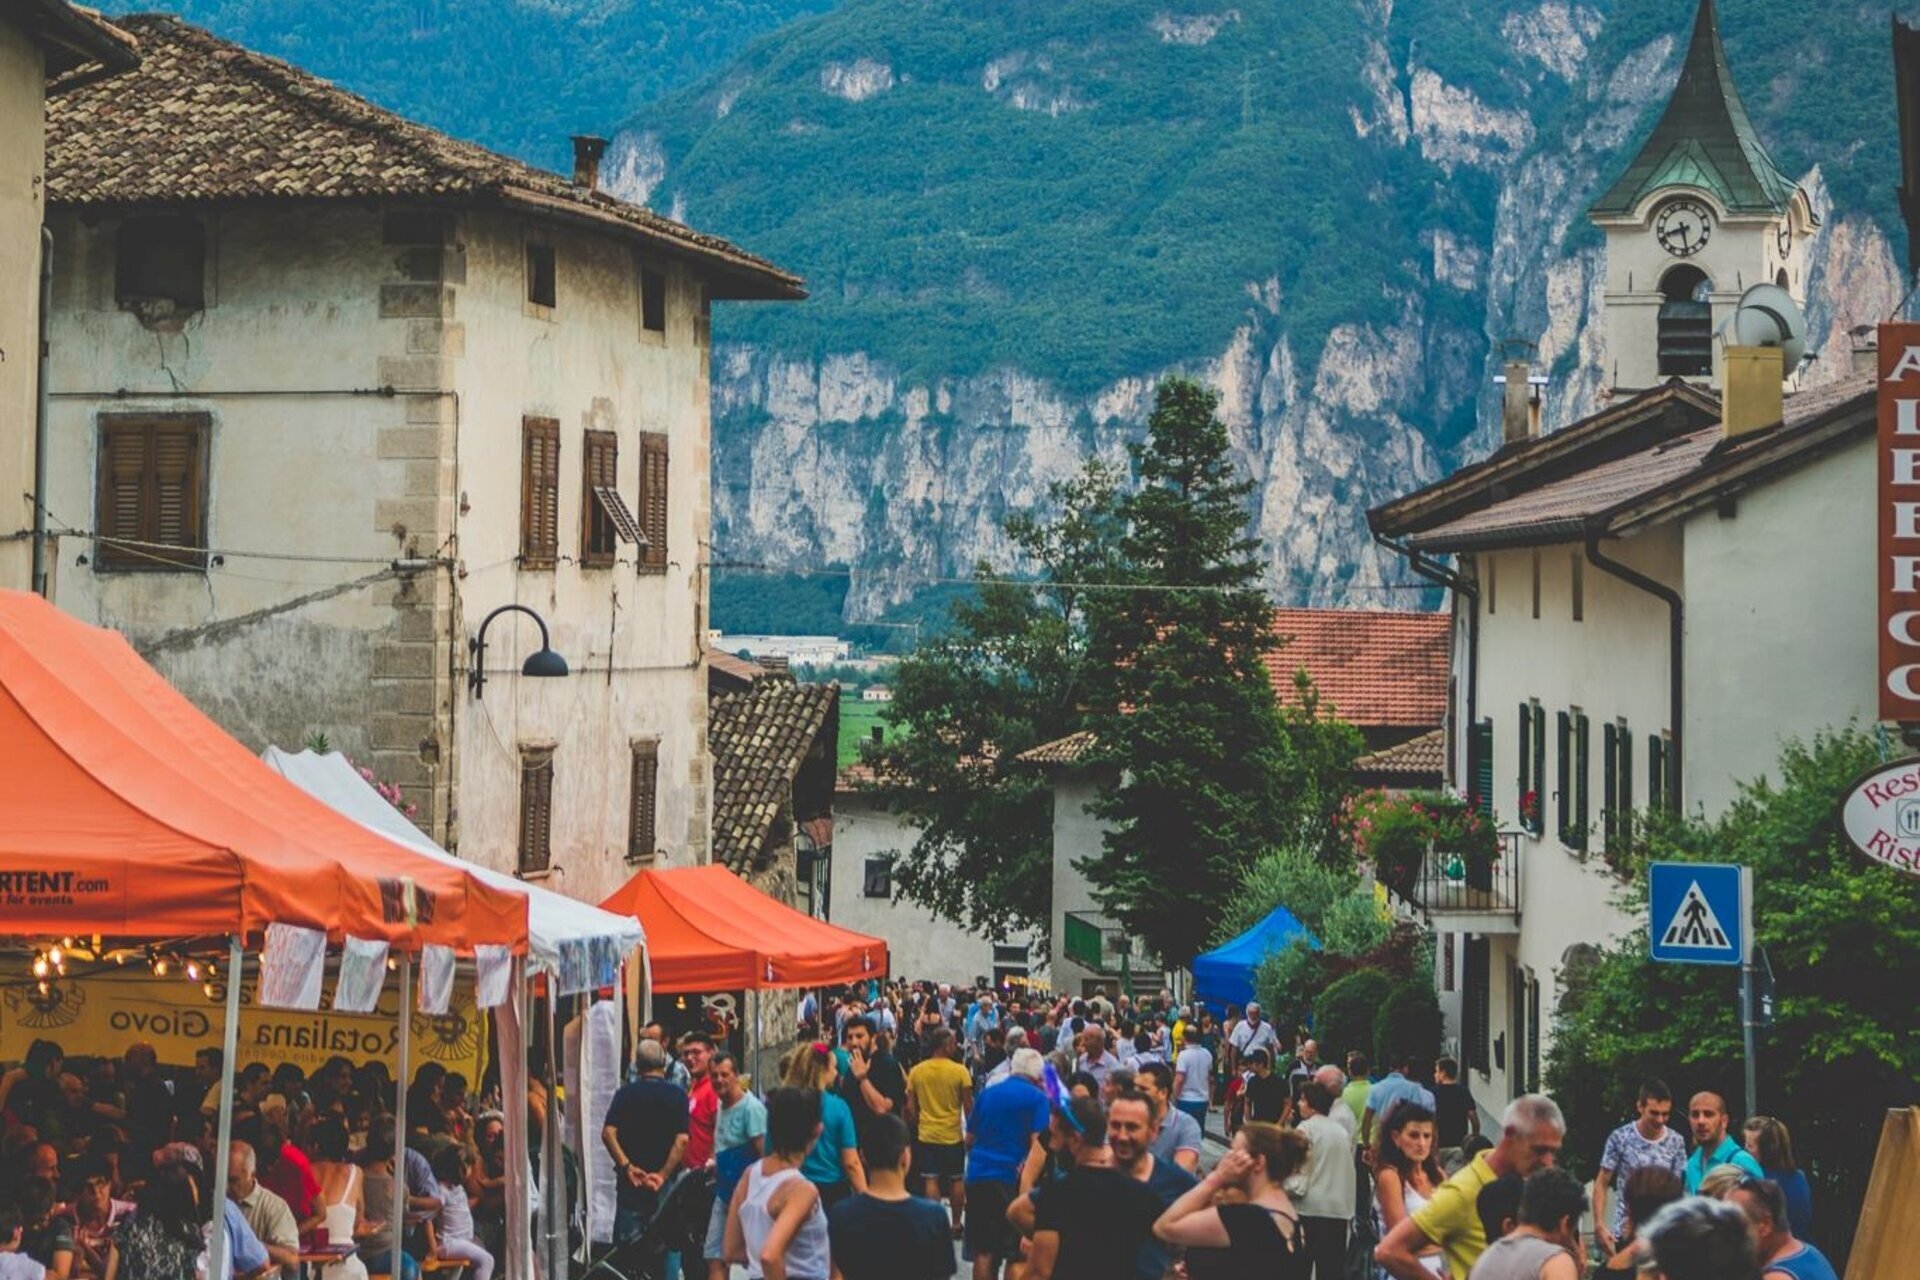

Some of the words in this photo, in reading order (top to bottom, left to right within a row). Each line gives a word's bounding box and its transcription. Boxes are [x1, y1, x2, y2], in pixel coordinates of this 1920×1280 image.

[1863, 767, 1920, 808] Res
[7, 895, 24, 905] for
[29, 896, 73, 906] events
